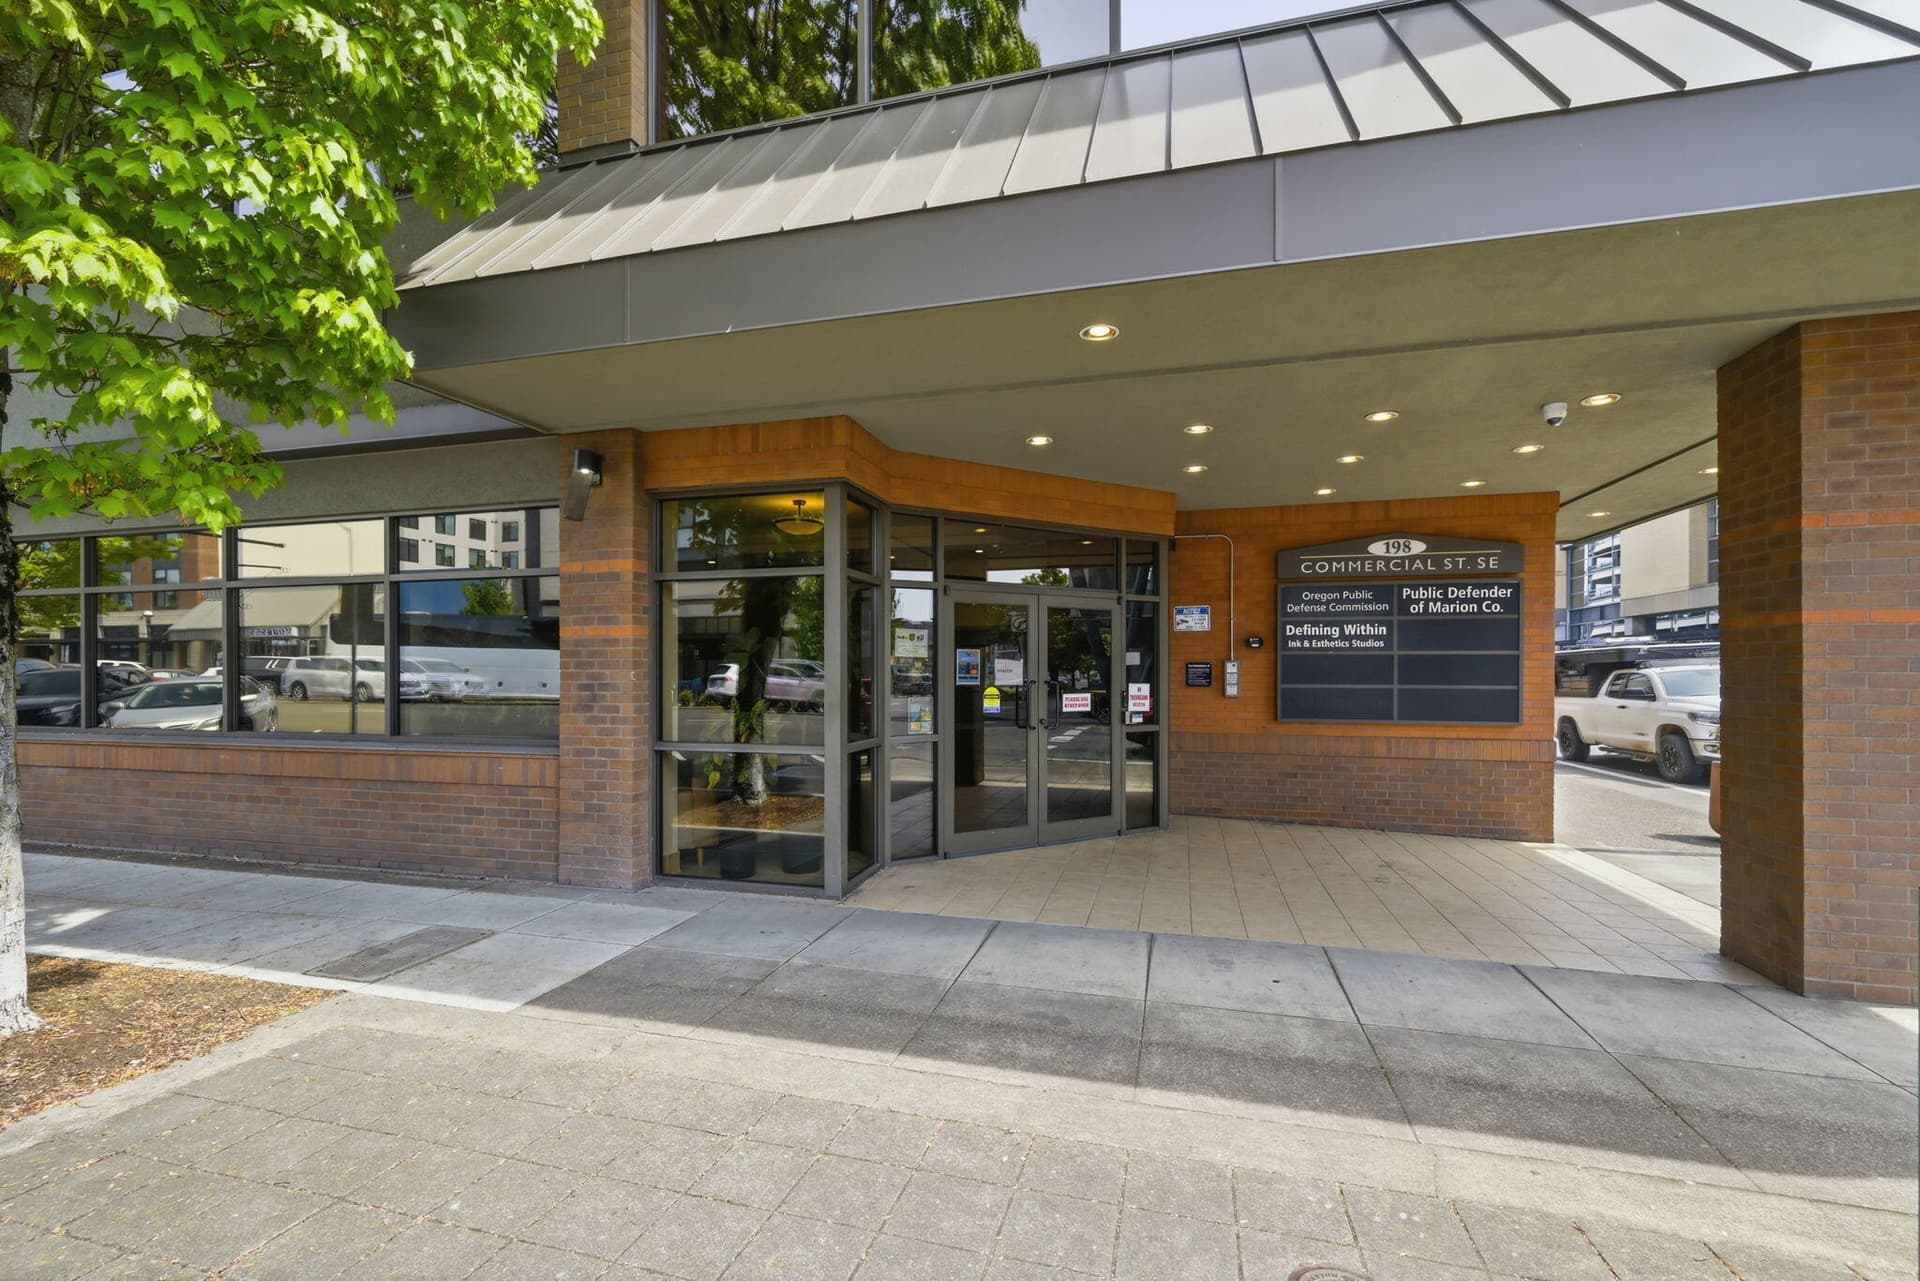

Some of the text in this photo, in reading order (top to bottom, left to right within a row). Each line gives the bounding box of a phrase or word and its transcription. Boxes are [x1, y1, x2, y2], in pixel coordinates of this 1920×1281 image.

[1384, 540, 1412, 555] 198
[1301, 556, 1499, 574] COMMERCIAL ST. SE
[1302, 589, 1374, 602] Oregon Public
[1402, 585, 1513, 599] Public Defender
[1287, 601, 1390, 613] Defense Commission
[1410, 600, 1504, 613] of Marion Co.
[1286, 623, 1387, 639] Defining Within
[1288, 639, 1385, 648] Ink & Esthetics Studios
